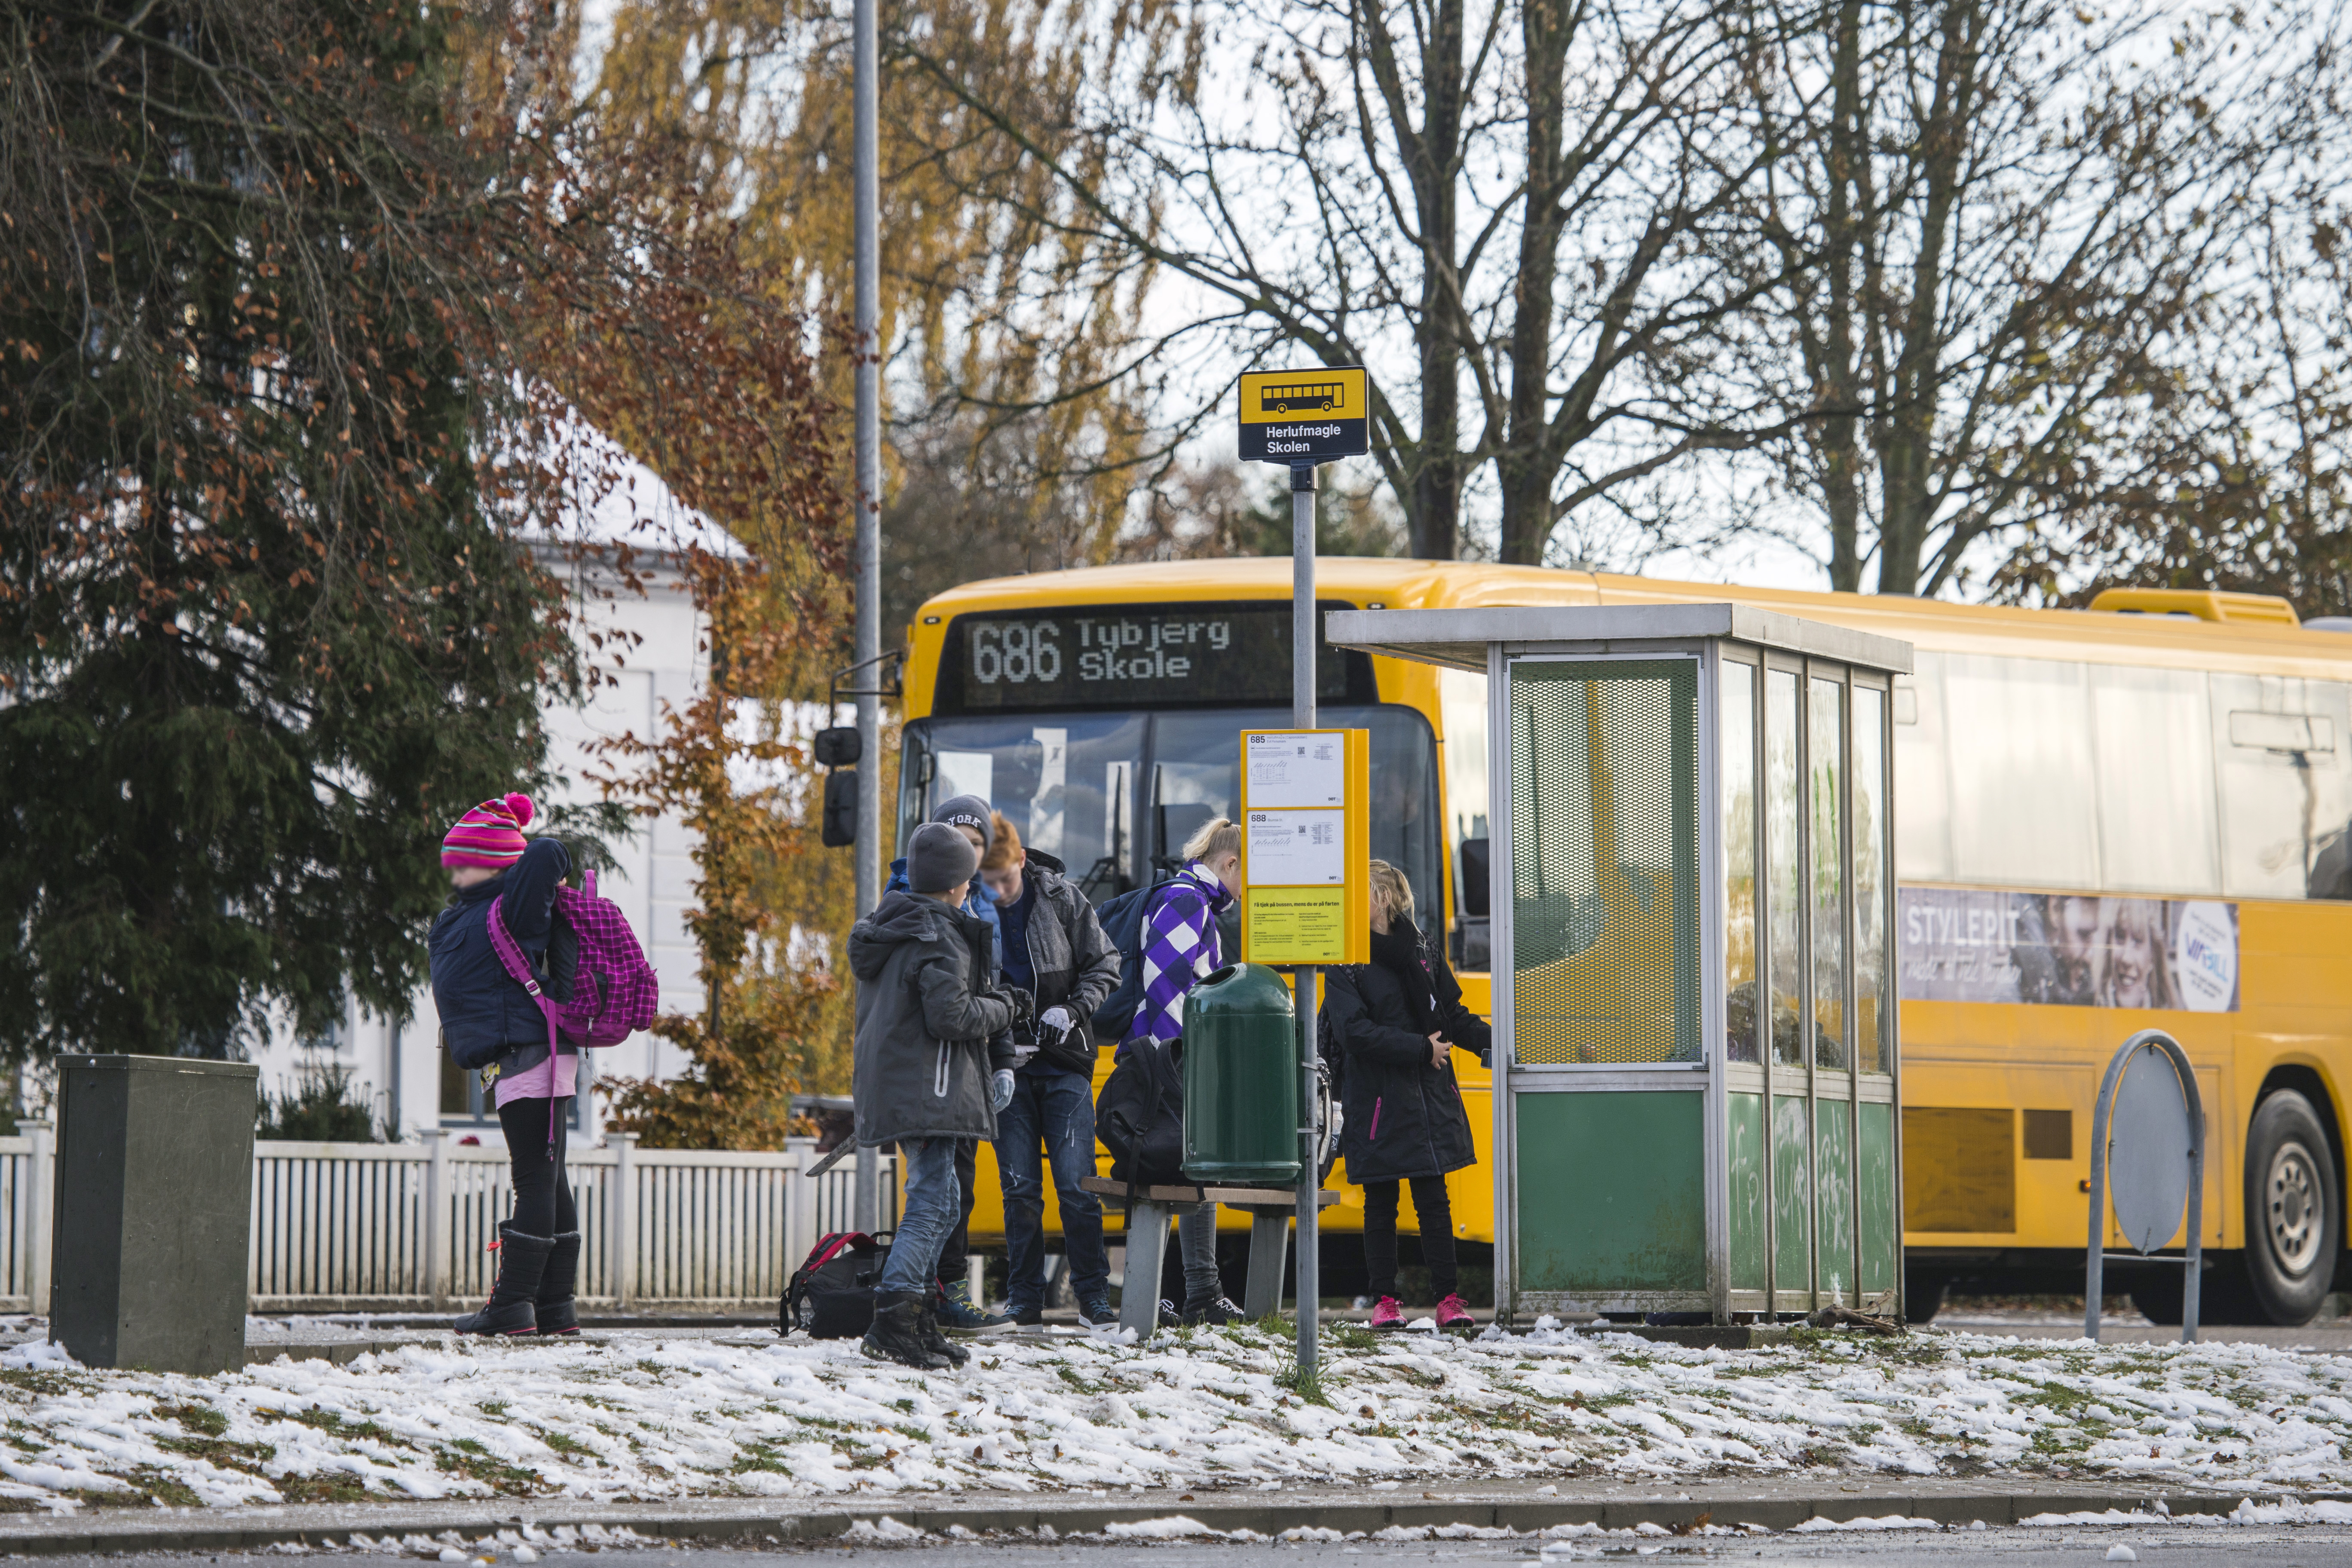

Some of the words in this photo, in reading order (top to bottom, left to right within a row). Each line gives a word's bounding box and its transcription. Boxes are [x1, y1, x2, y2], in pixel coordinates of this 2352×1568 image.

[1267, 424, 1341, 438] Herlufmagle
[1267, 441, 1310, 453] Skolen
[1075, 617, 1229, 652] Tybjerg
[973, 620, 1061, 683] 686
[1079, 648, 1191, 680] Skole
[948, 815, 981, 828] YORK
[1907, 904, 2020, 948] STYLEPIT
[818, 1238, 835, 1253] hummel
